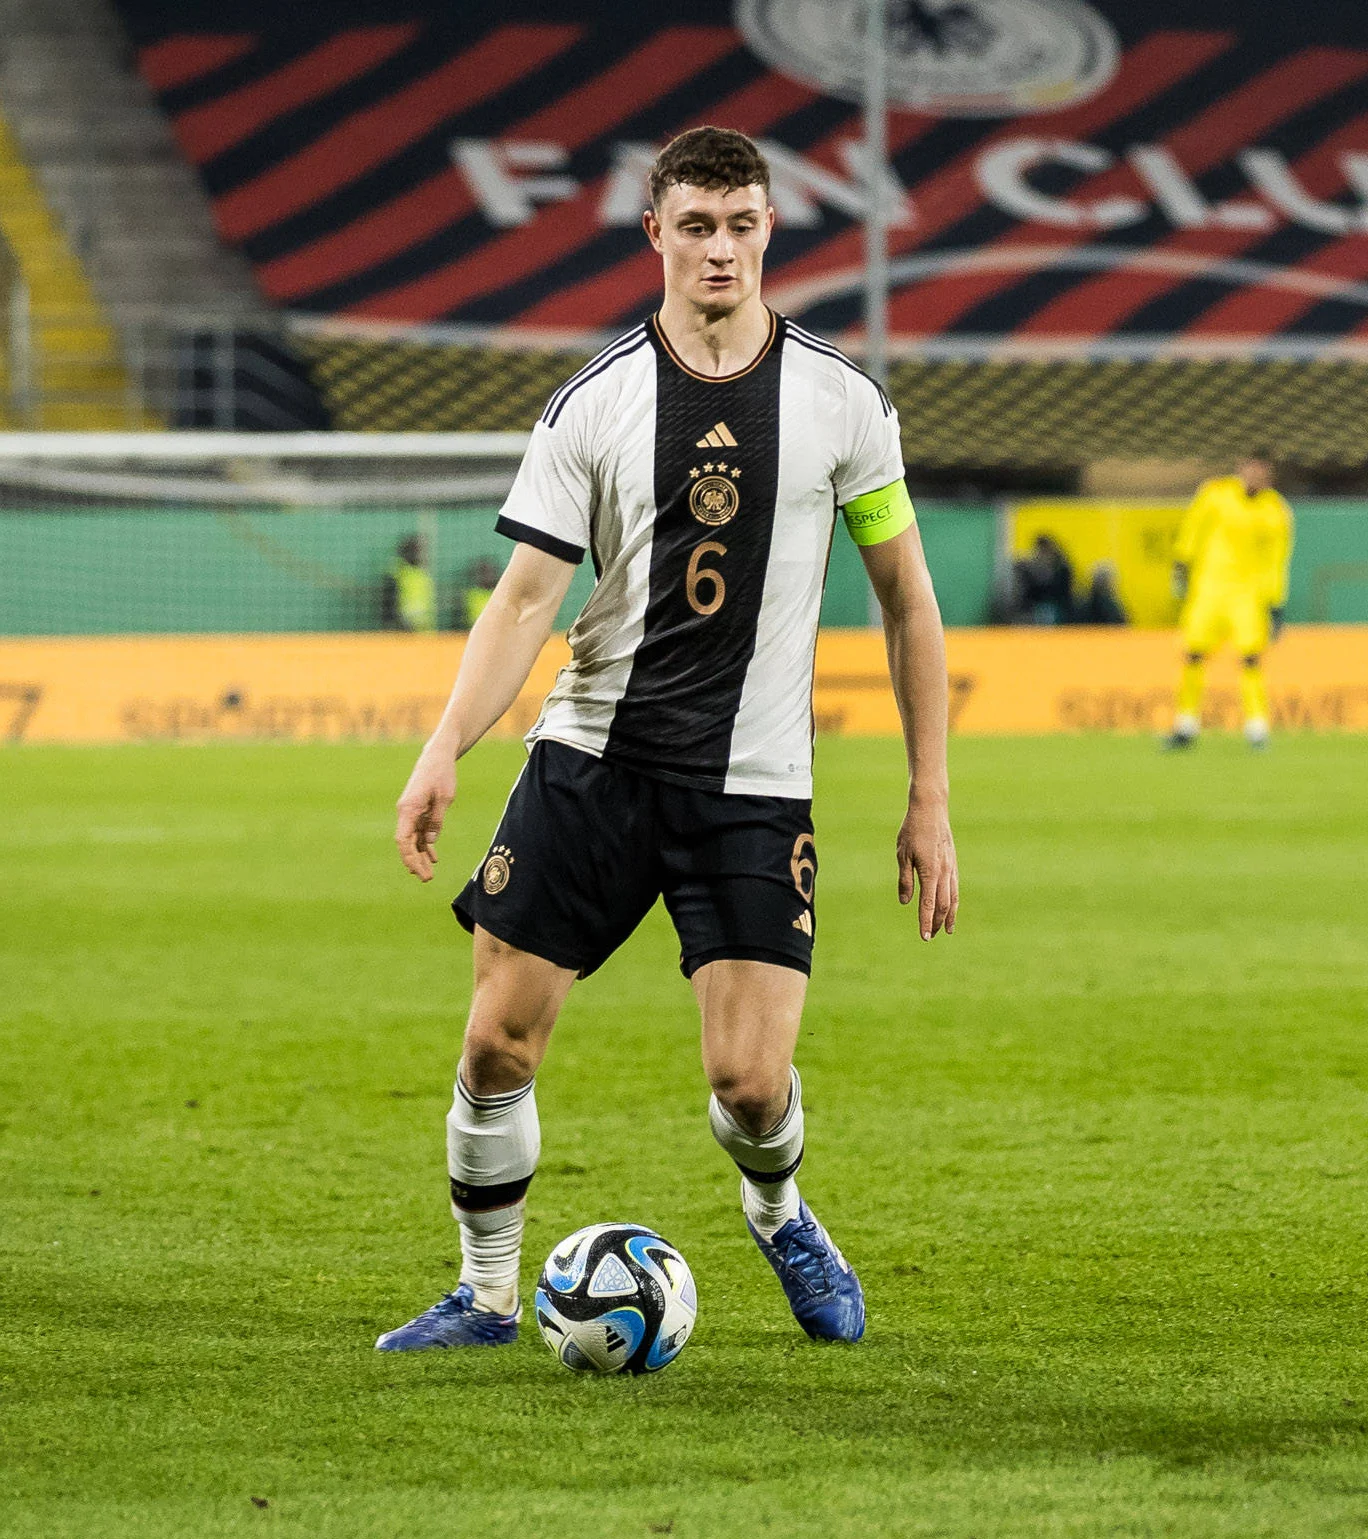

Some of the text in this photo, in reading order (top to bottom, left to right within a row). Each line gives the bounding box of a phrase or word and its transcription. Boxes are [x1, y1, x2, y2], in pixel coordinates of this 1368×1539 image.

[846, 504, 892, 526] ESPECT
[686, 541, 727, 615] 6
[791, 833, 815, 903] 6
